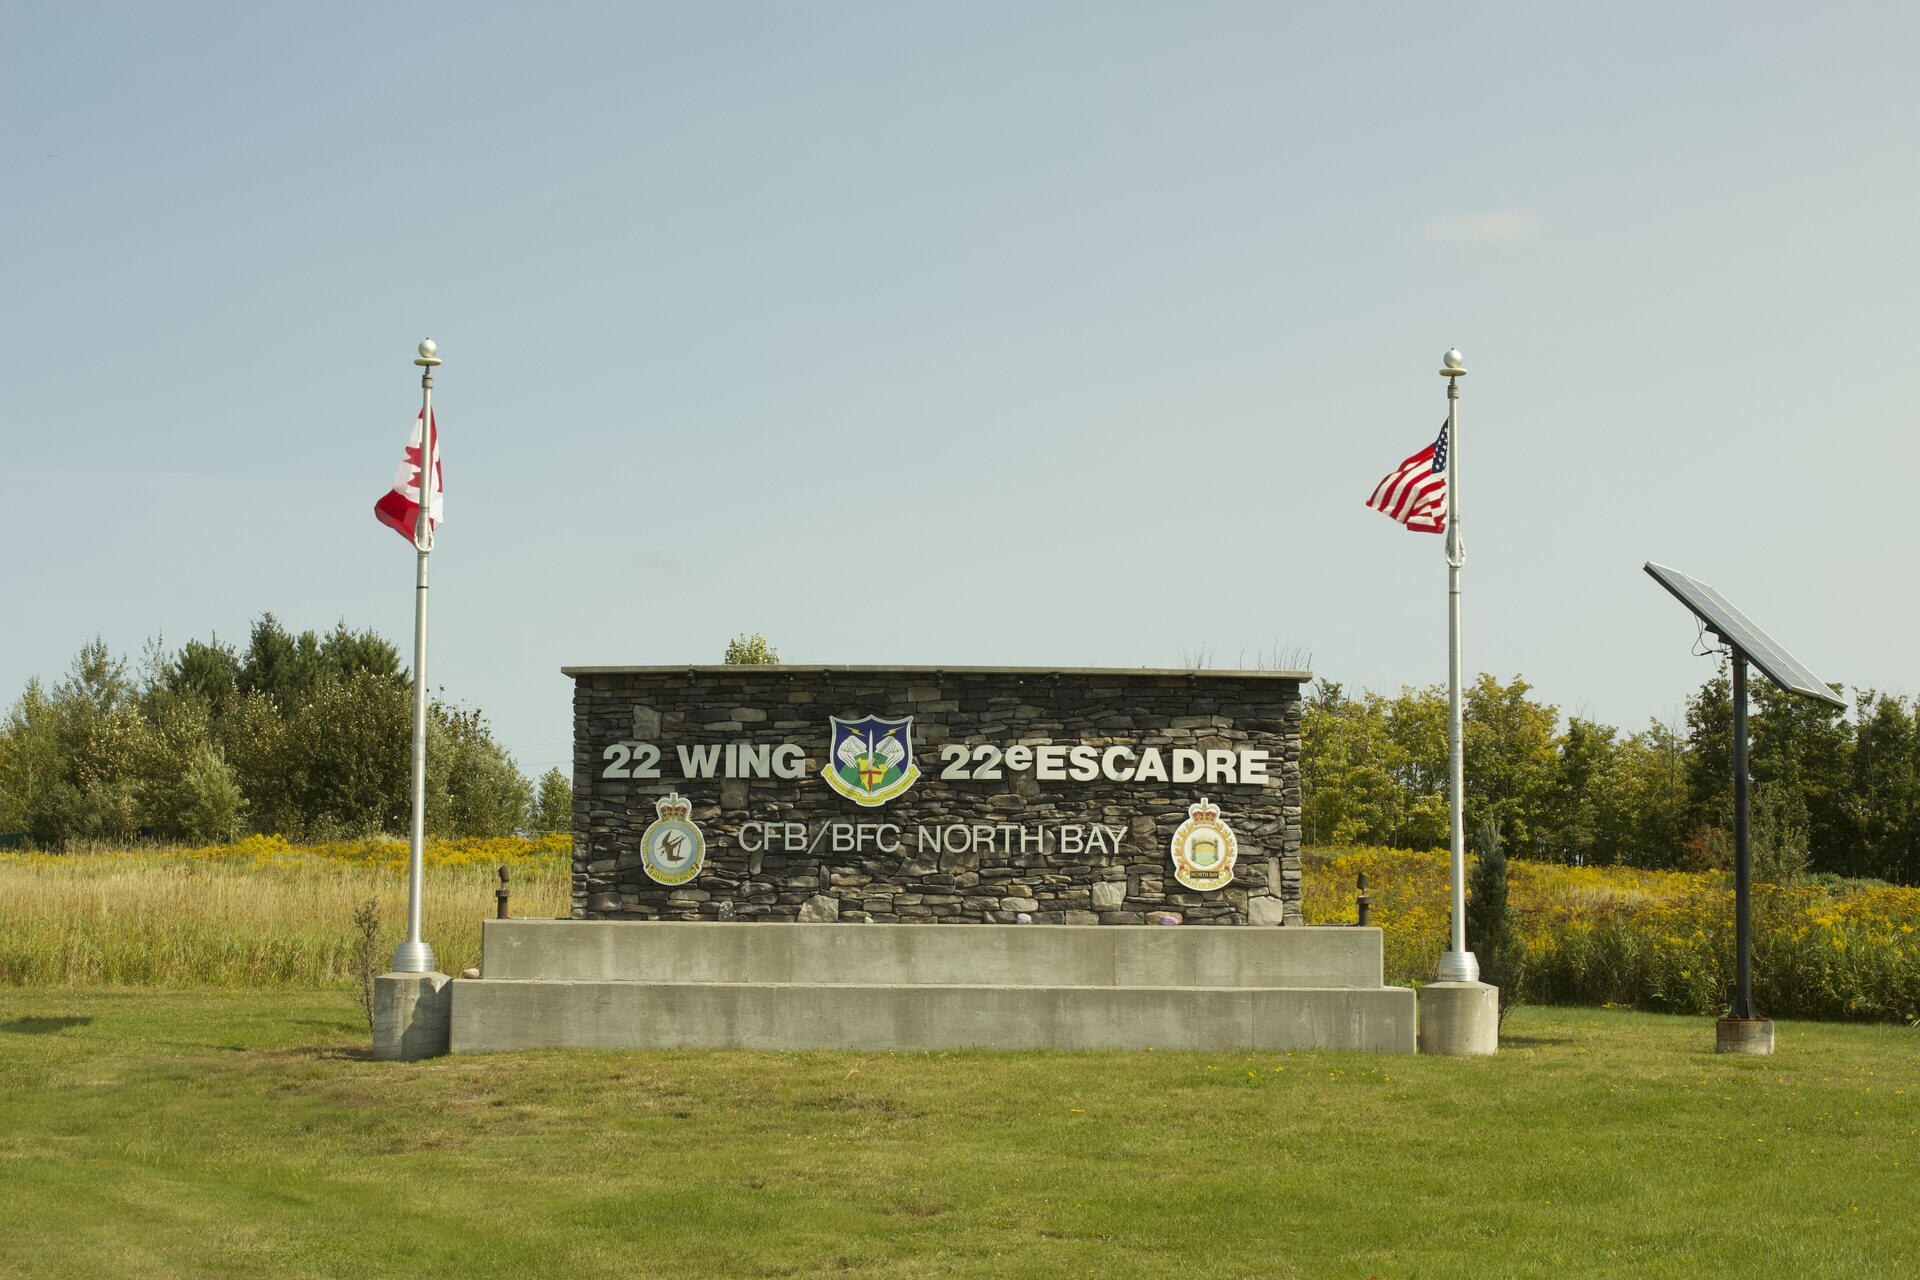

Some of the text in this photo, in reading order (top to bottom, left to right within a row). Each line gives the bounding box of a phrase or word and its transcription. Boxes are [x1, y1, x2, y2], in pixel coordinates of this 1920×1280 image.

[602, 744, 806, 780] 22 WING
[940, 744, 1270, 785] 22e ESCADRE
[738, 820, 1129, 855] CFB/BFC NORTH BAY
